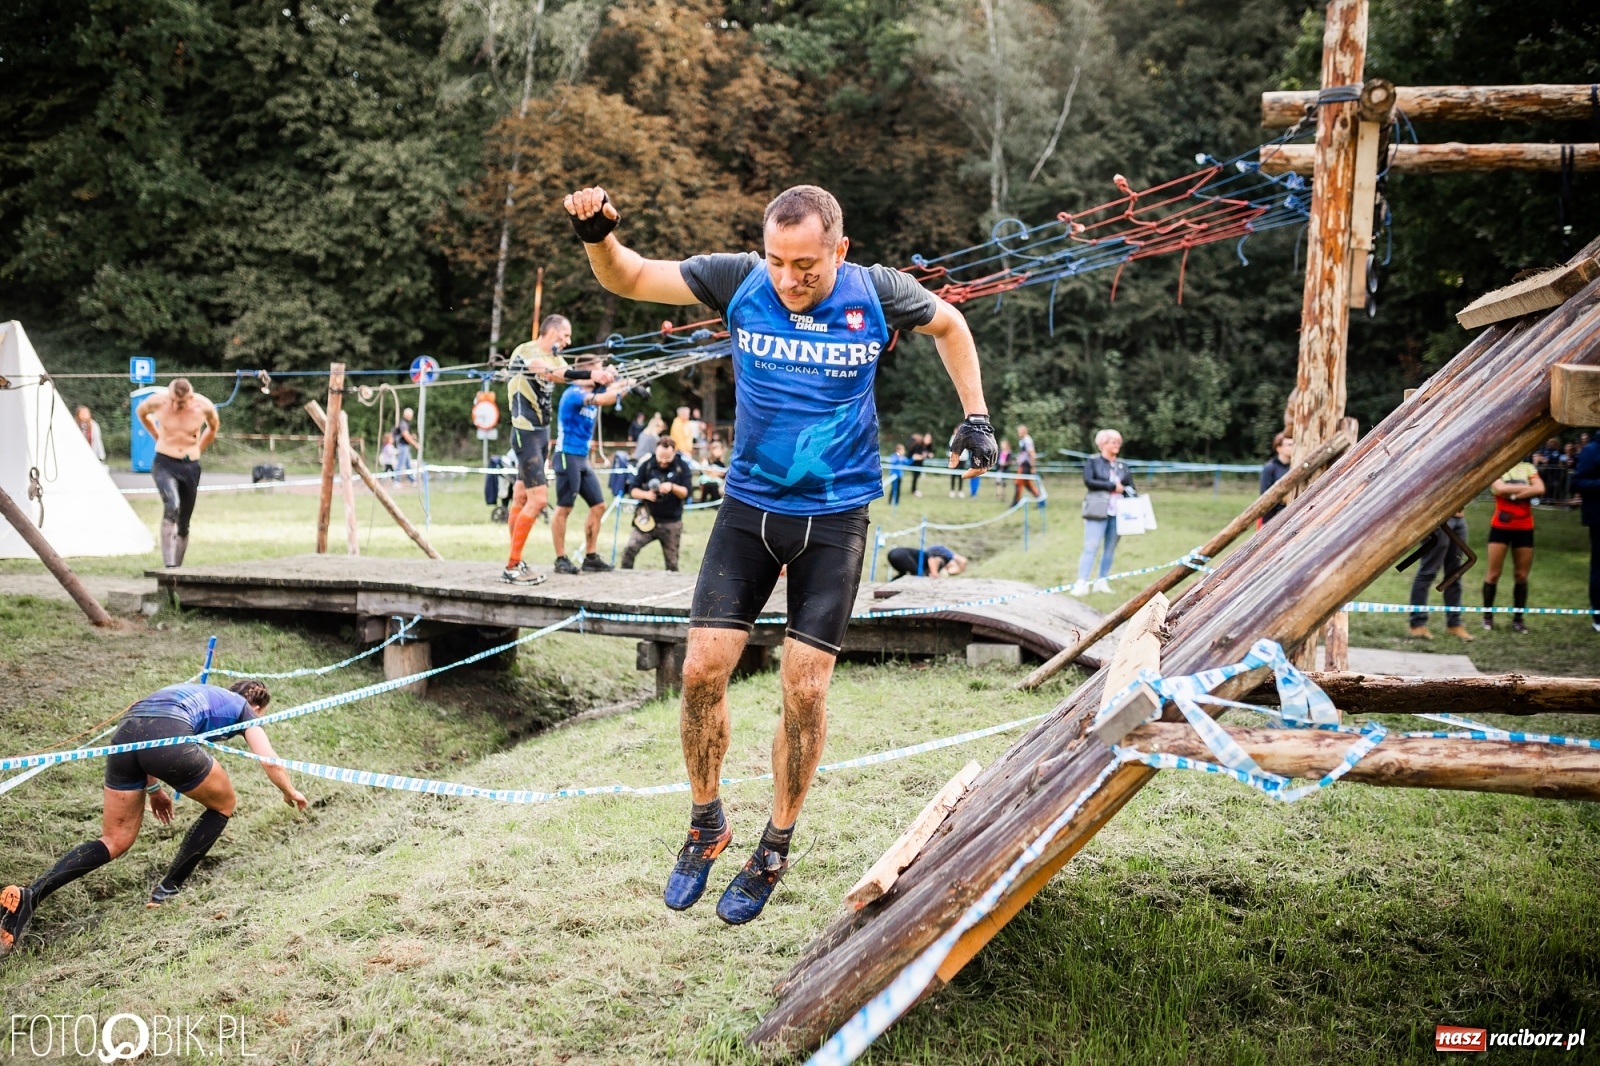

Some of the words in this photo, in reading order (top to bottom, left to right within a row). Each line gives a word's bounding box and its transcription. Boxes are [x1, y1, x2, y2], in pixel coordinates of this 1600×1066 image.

[789, 313, 814, 324] EKO
[795, 321, 828, 333] OKNA
[736, 327, 882, 366] RUNNERS
[135, 359, 151, 381] P
[824, 368, 858, 378] TEAM
